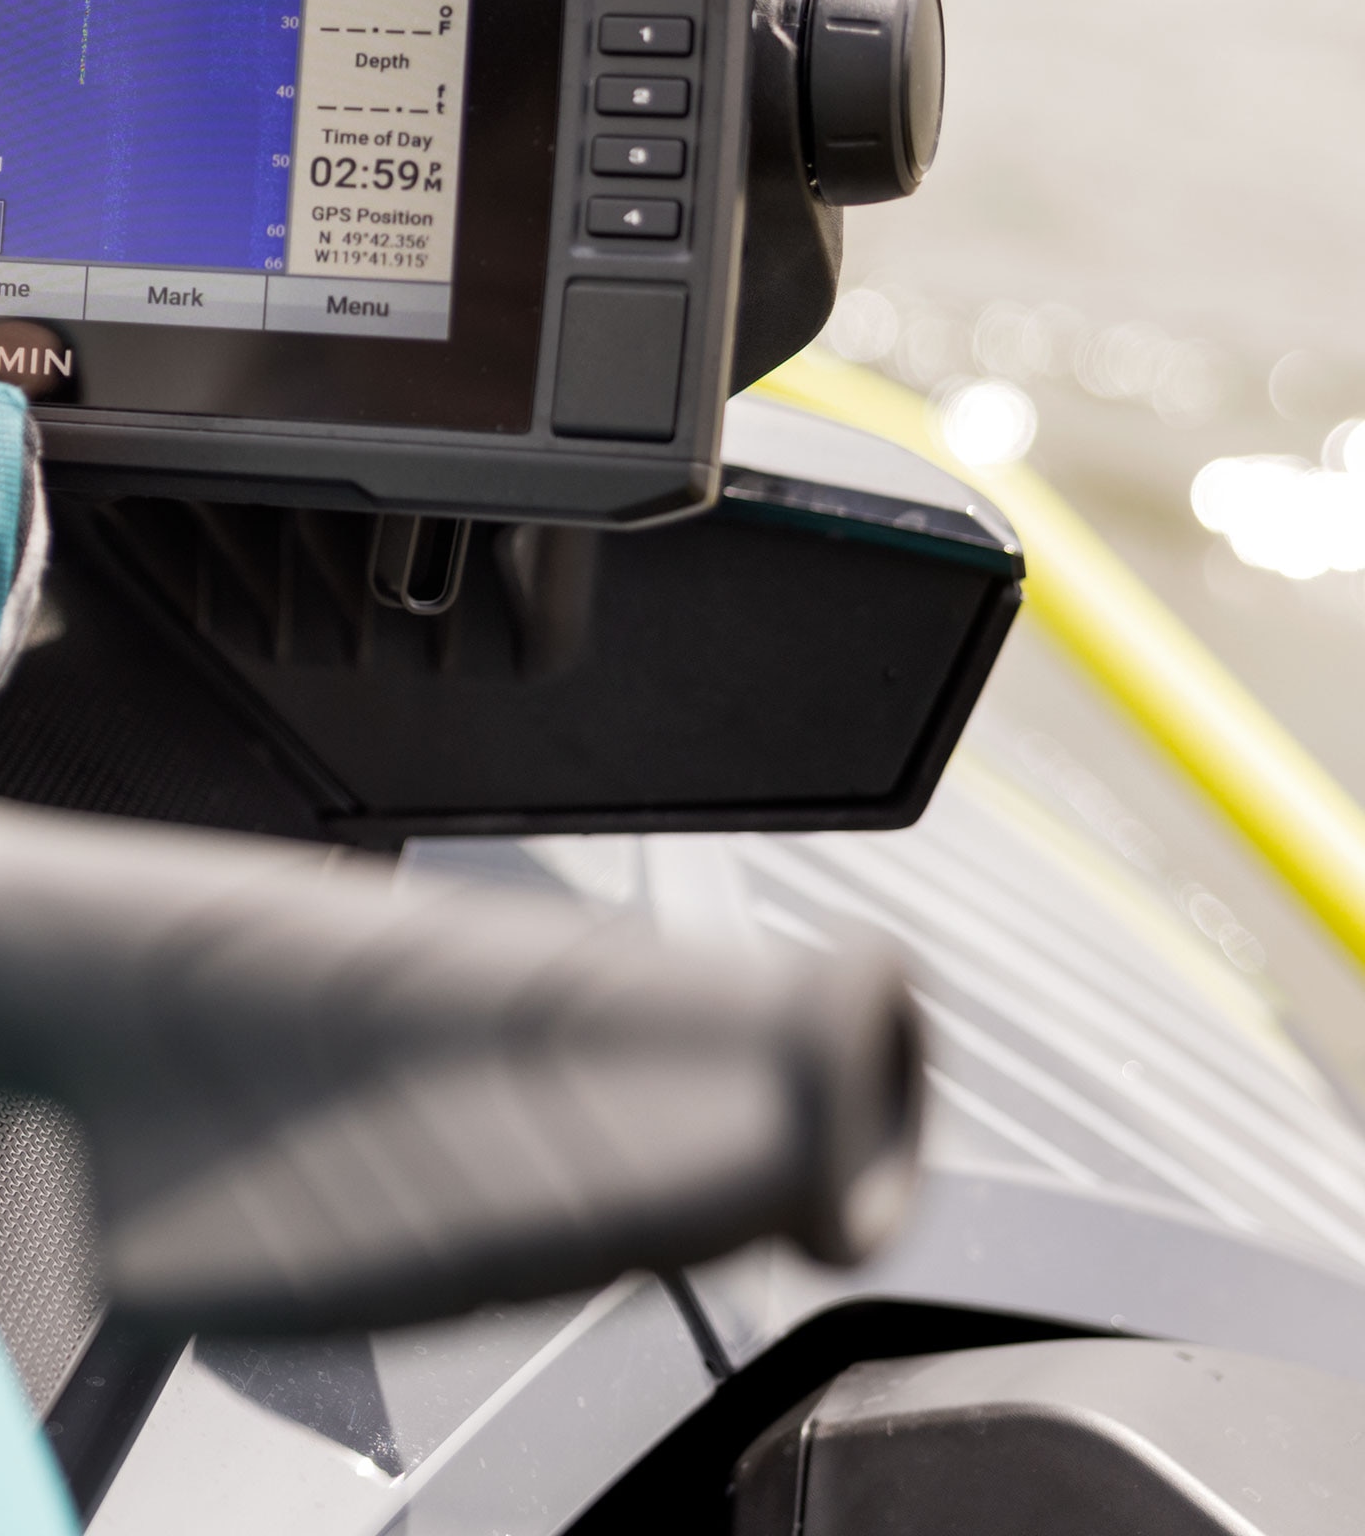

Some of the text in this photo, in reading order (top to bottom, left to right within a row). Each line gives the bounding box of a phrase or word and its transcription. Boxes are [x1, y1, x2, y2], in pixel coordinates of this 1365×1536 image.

[281, 16, 299, 29] 30
[639, 26, 652, 43] 1
[355, 52, 410, 72] Depth
[276, 85, 295, 98] 40
[632, 87, 651, 105] 2
[322, 129, 433, 151] Time of Day
[272, 154, 290, 168] 50
[628, 147, 647, 165] 3
[310, 156, 419, 191] 02:59
[312, 206, 433, 226] GPS Position
[623, 209, 642, 226] 4
[267, 224, 286, 238] 60
[319, 231, 332, 245] N
[264, 256, 283, 270] 66
[147, 286, 204, 307] Mark
[326, 295, 390, 317] Menu
